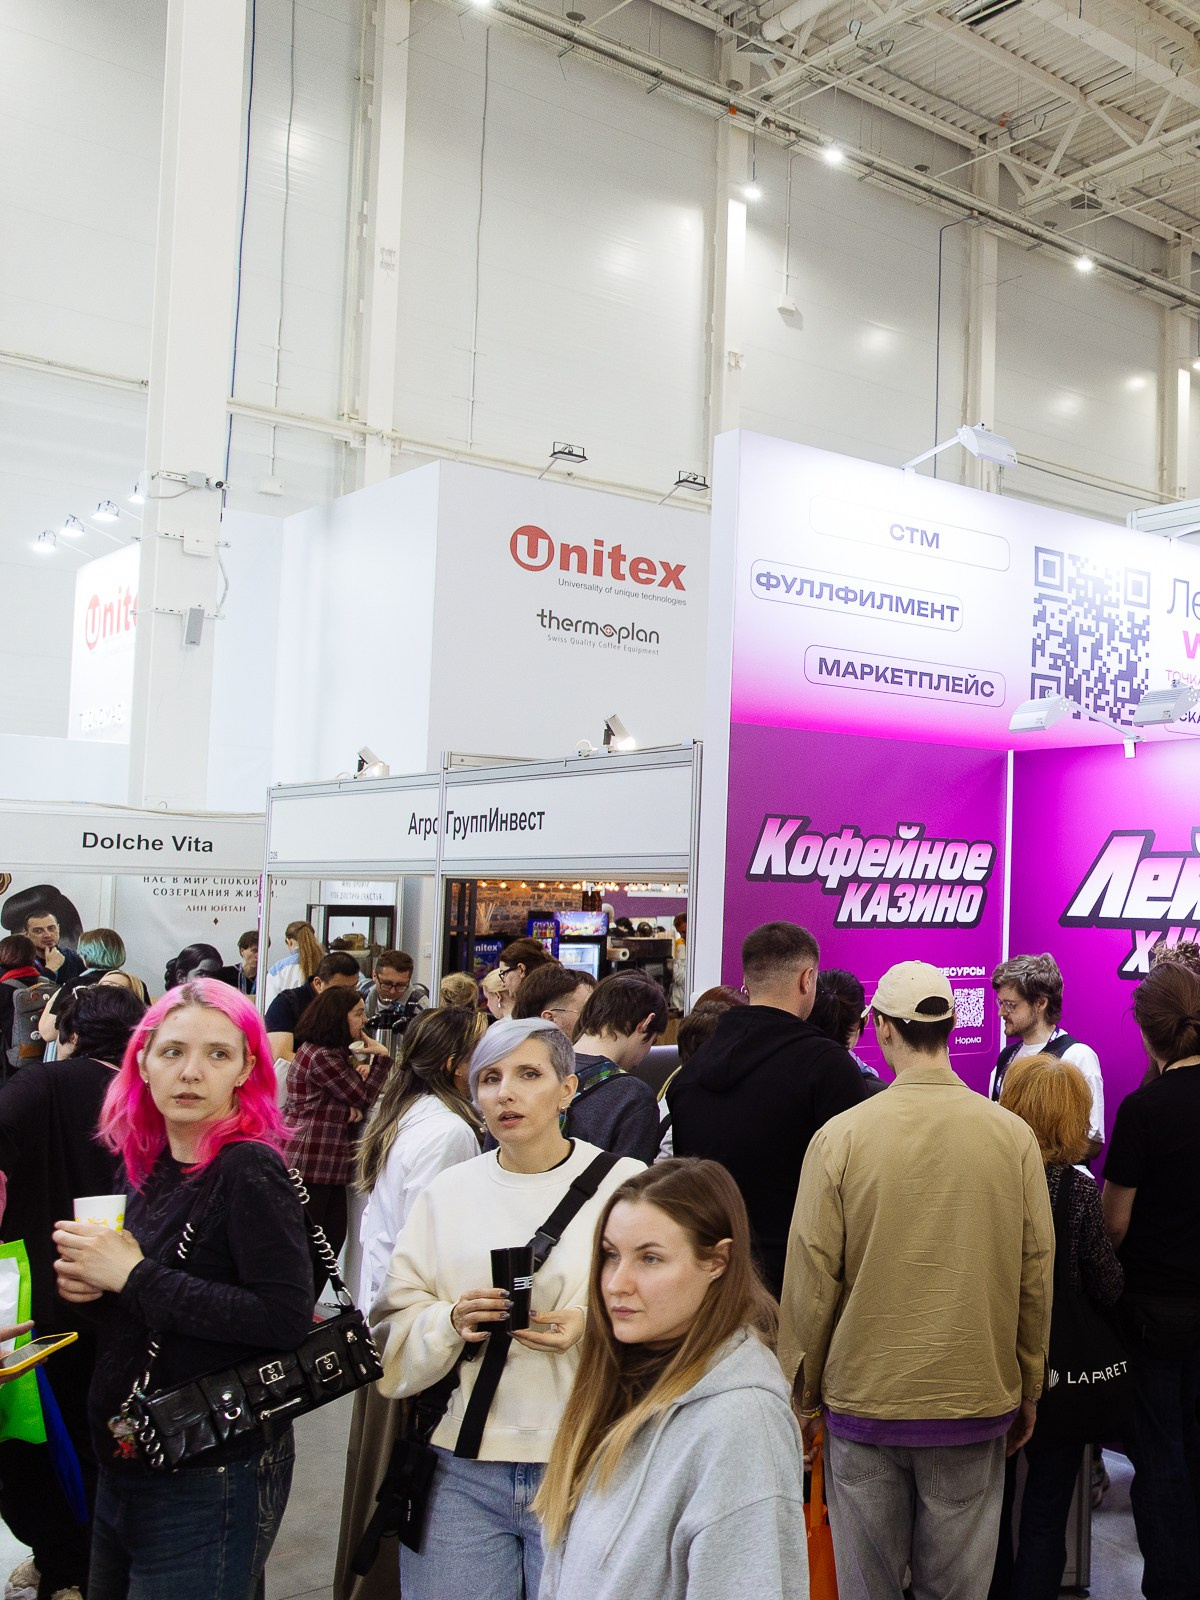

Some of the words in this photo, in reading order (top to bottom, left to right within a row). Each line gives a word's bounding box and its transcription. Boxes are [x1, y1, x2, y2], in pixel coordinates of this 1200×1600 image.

[889, 523, 940, 549] СТМ
[510, 525, 687, 591] Unitex
[558, 578, 603, 594] Universality
[604, 586, 613, 594] of
[614, 589, 640, 599] unique
[641, 592, 687, 606] technologies
[755, 572, 960, 623] ФУЛЛФИЛМЕНТ
[85, 585, 139, 650] Unit
[536, 608, 660, 644] thermoplan
[547, 634, 568, 643] Swiss
[570, 637, 596, 649] Quality
[598, 640, 621, 650] Coffee
[623, 645, 660, 656] Equipment
[817, 657, 995, 698] МАРКЕТПЛЕЙС
[82, 831, 164, 851] Dolche
[171, 835, 214, 852] Vita
[749, 816, 994, 889] Кофейное
[152, 888, 230, 898] СОЗЕРЦАНИЯ
[836, 882, 984, 923] КАЗИНО
[474, 943, 498, 952] nitex
[955, 1036, 982, 1045] Норма
[1067, 1360, 1127, 1384] LAPARET
